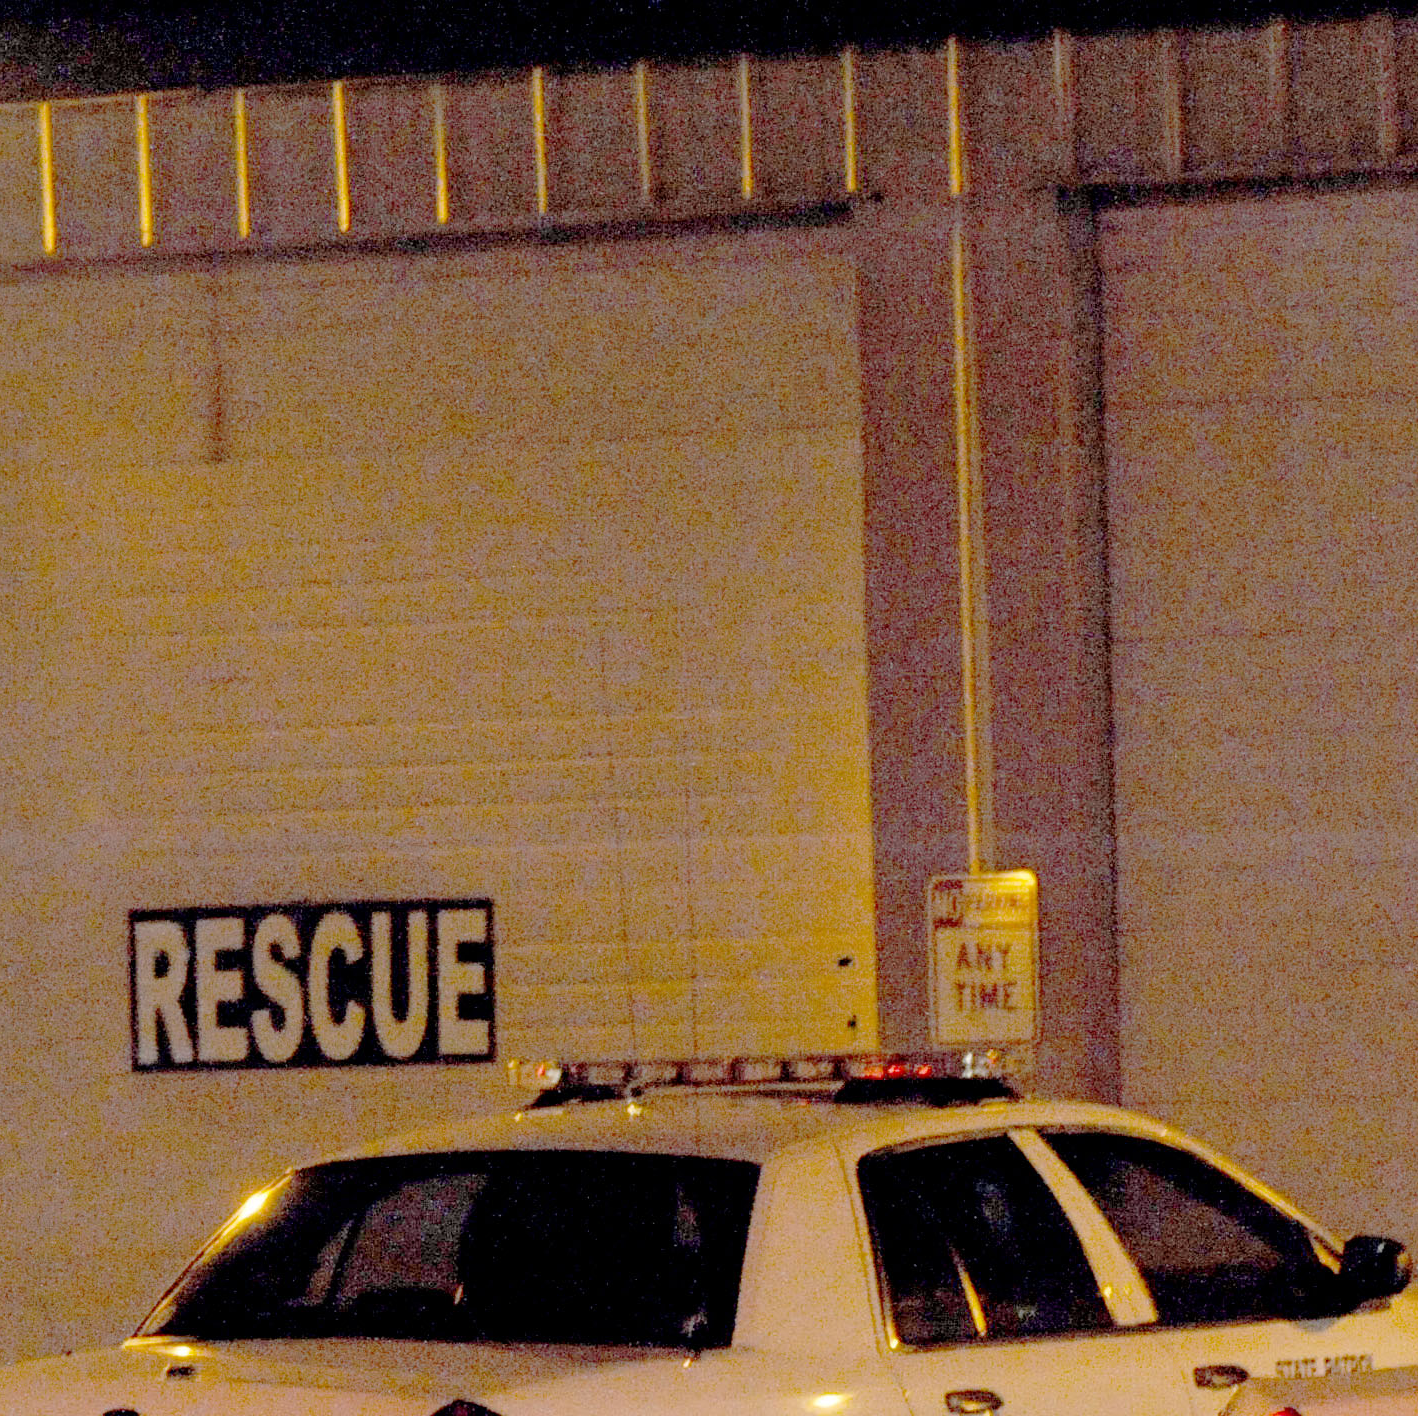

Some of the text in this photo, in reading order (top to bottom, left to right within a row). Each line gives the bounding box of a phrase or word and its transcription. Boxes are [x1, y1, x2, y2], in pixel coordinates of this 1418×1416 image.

[955, 942, 1012, 971] ANY
[135, 908, 490, 1066] RESCUE
[954, 980, 1018, 1013] TIME
